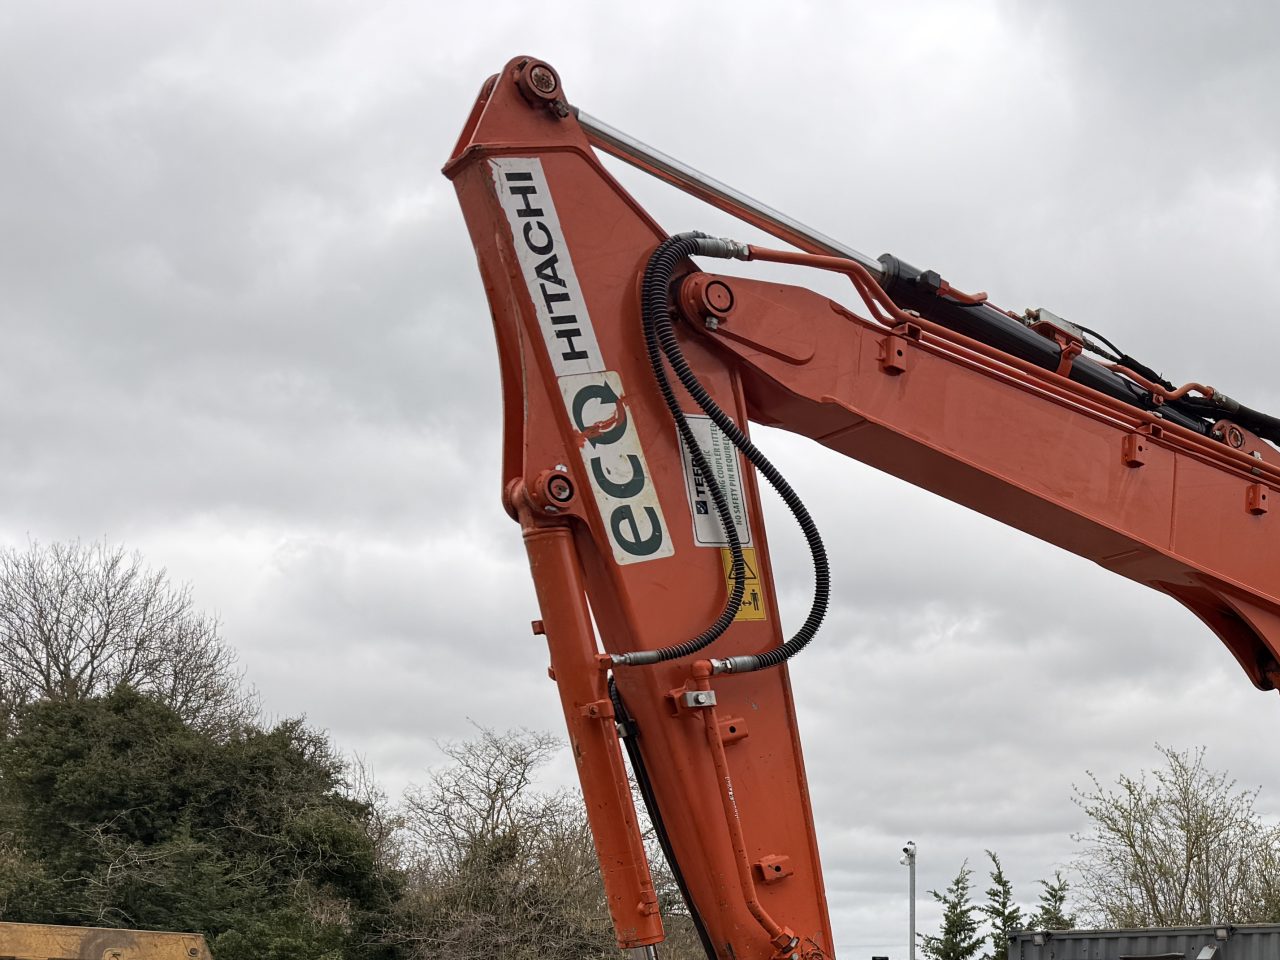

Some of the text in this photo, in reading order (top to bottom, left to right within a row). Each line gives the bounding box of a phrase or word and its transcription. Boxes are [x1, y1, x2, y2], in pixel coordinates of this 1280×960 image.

[505, 171, 589, 361] HITACHI
[710, 421, 719, 447] FITTED
[713, 448, 725, 479] COUPLER
[723, 433, 743, 527] NO SAFETY PIN REQUIRED
